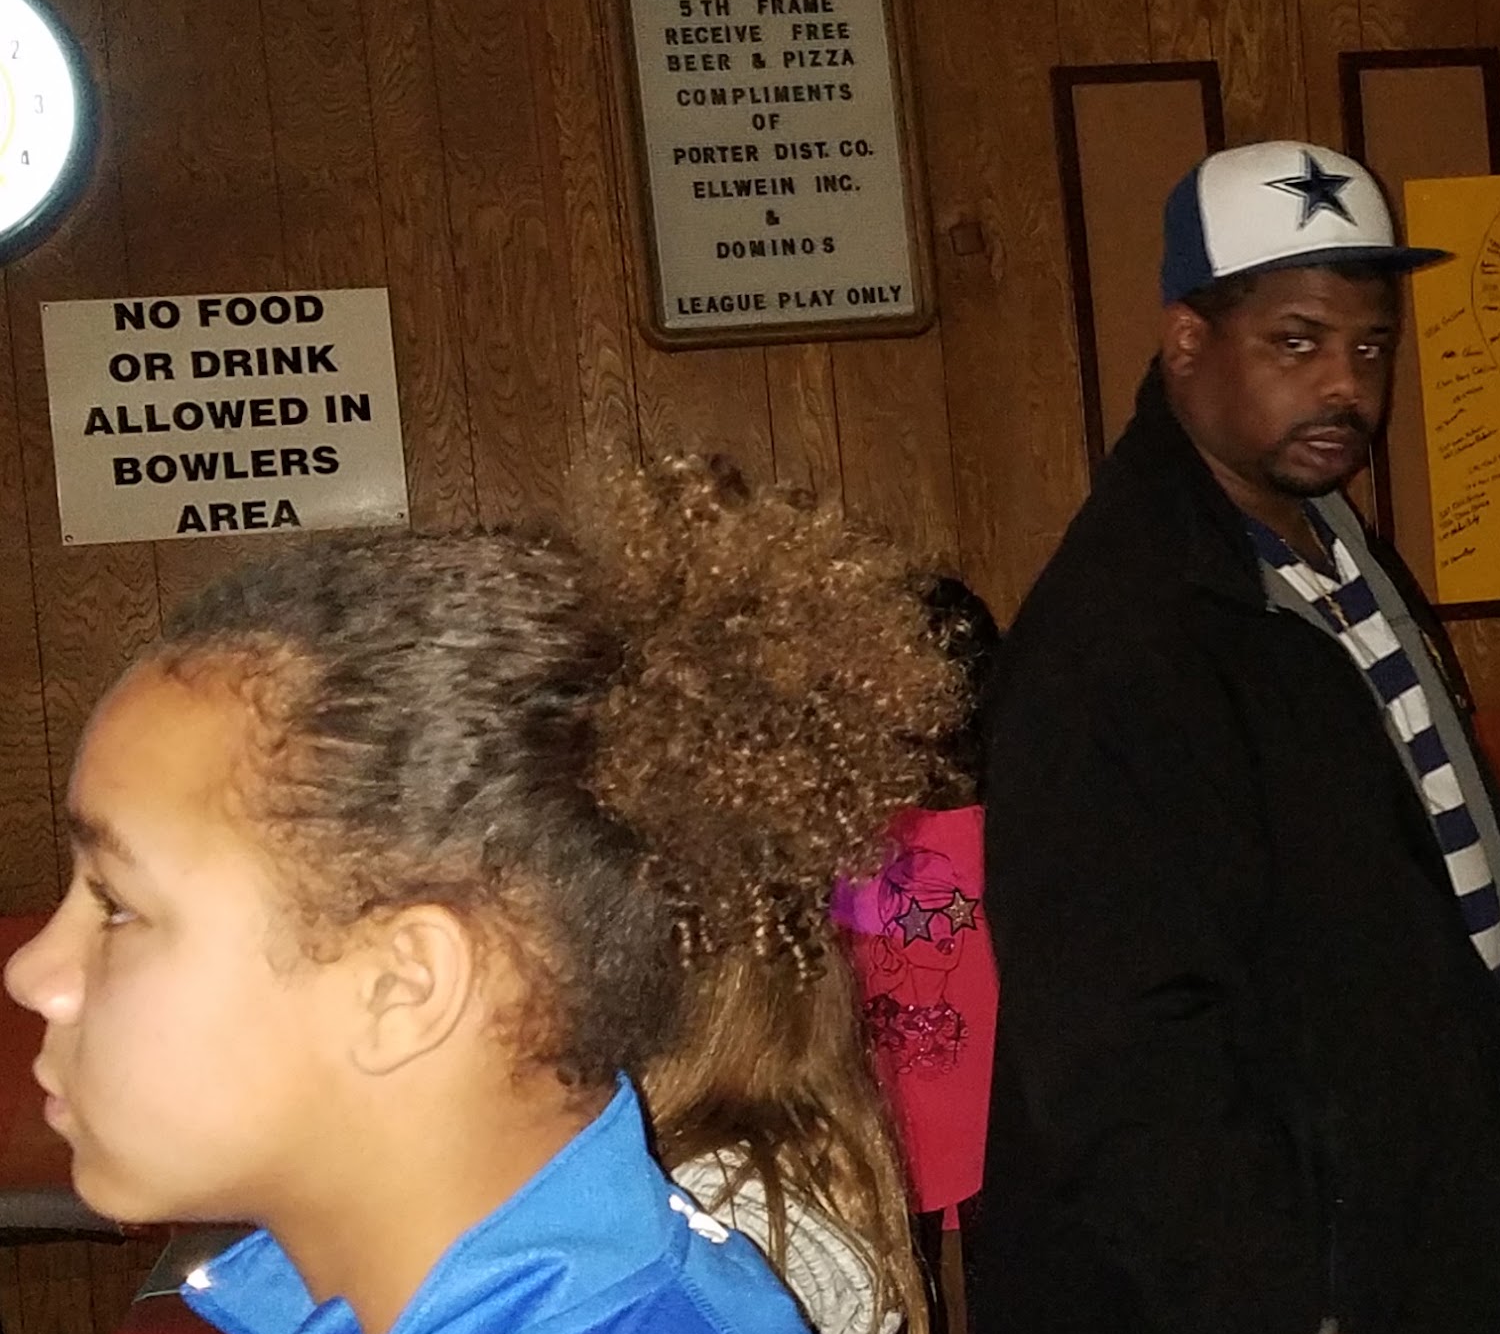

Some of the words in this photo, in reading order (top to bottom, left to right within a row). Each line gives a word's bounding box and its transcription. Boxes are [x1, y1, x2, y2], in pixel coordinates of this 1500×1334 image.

[665, 25, 762, 45] RECEIVE
[792, 22, 850, 42] FREE
[667, 53, 731, 72] BEER
[752, 52, 766, 68] &
[783, 49, 855, 68] PIZZA
[677, 83, 852, 106] COMPLIMENTS
[752, 113, 780, 130] OF
[673, 145, 759, 165] PORTER
[775, 142, 829, 160] DIST.
[839, 139, 874, 156] CO.
[693, 177, 795, 199] ELLWEIN
[815, 174, 861, 193] INC.
[765, 210, 780, 226] &
[717, 237, 835, 259] DOMINOS
[113, 301, 180, 330] NO
[197, 295, 325, 327] FOOD
[677, 294, 767, 315] LEAGUE
[778, 289, 835, 309] PLAY
[847, 285, 902, 305] ONLY
[109, 353, 175, 382] OR
[191, 344, 339, 379] DRINK
[84, 397, 308, 436] ALLOWED
[325, 394, 372, 423] IN
[113, 446, 340, 486] BOWLERS
[176, 499, 302, 534] AREA
